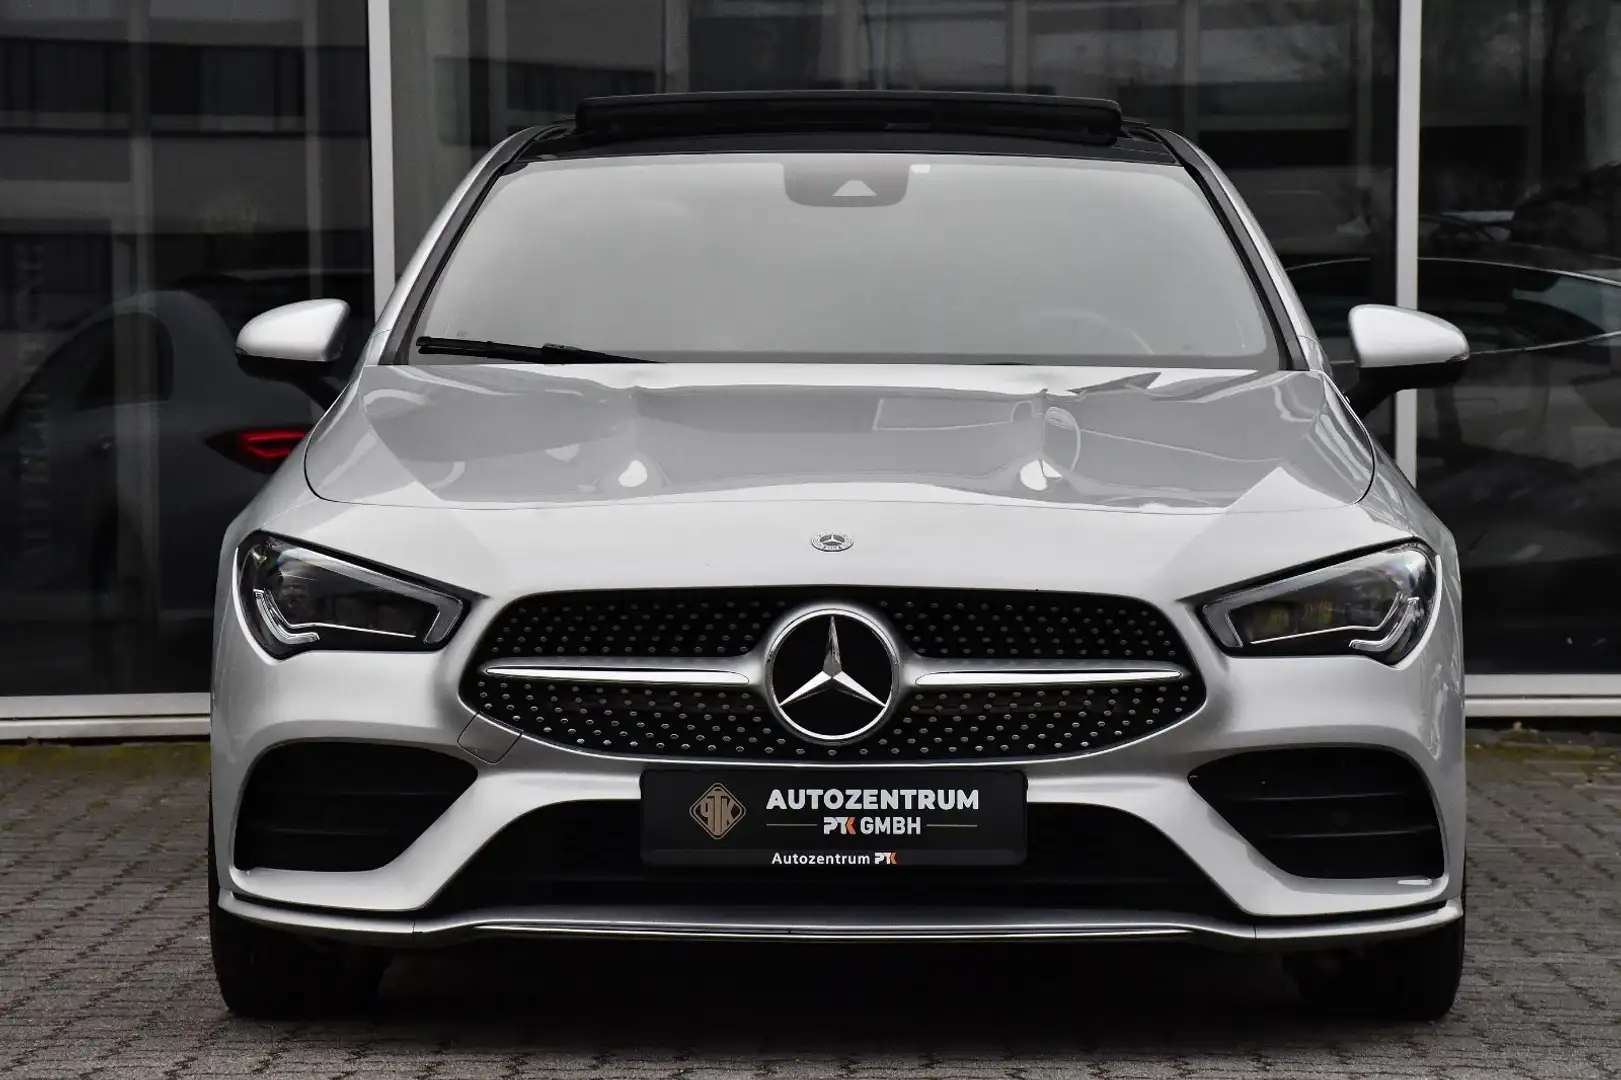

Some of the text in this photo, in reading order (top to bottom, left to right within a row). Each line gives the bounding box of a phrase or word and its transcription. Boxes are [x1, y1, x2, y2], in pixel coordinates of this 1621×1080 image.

[766, 789, 979, 810] AUTOZENTRUM
[823, 816, 921, 835] PTK GMBH
[771, 852, 870, 865] Autozentrum
